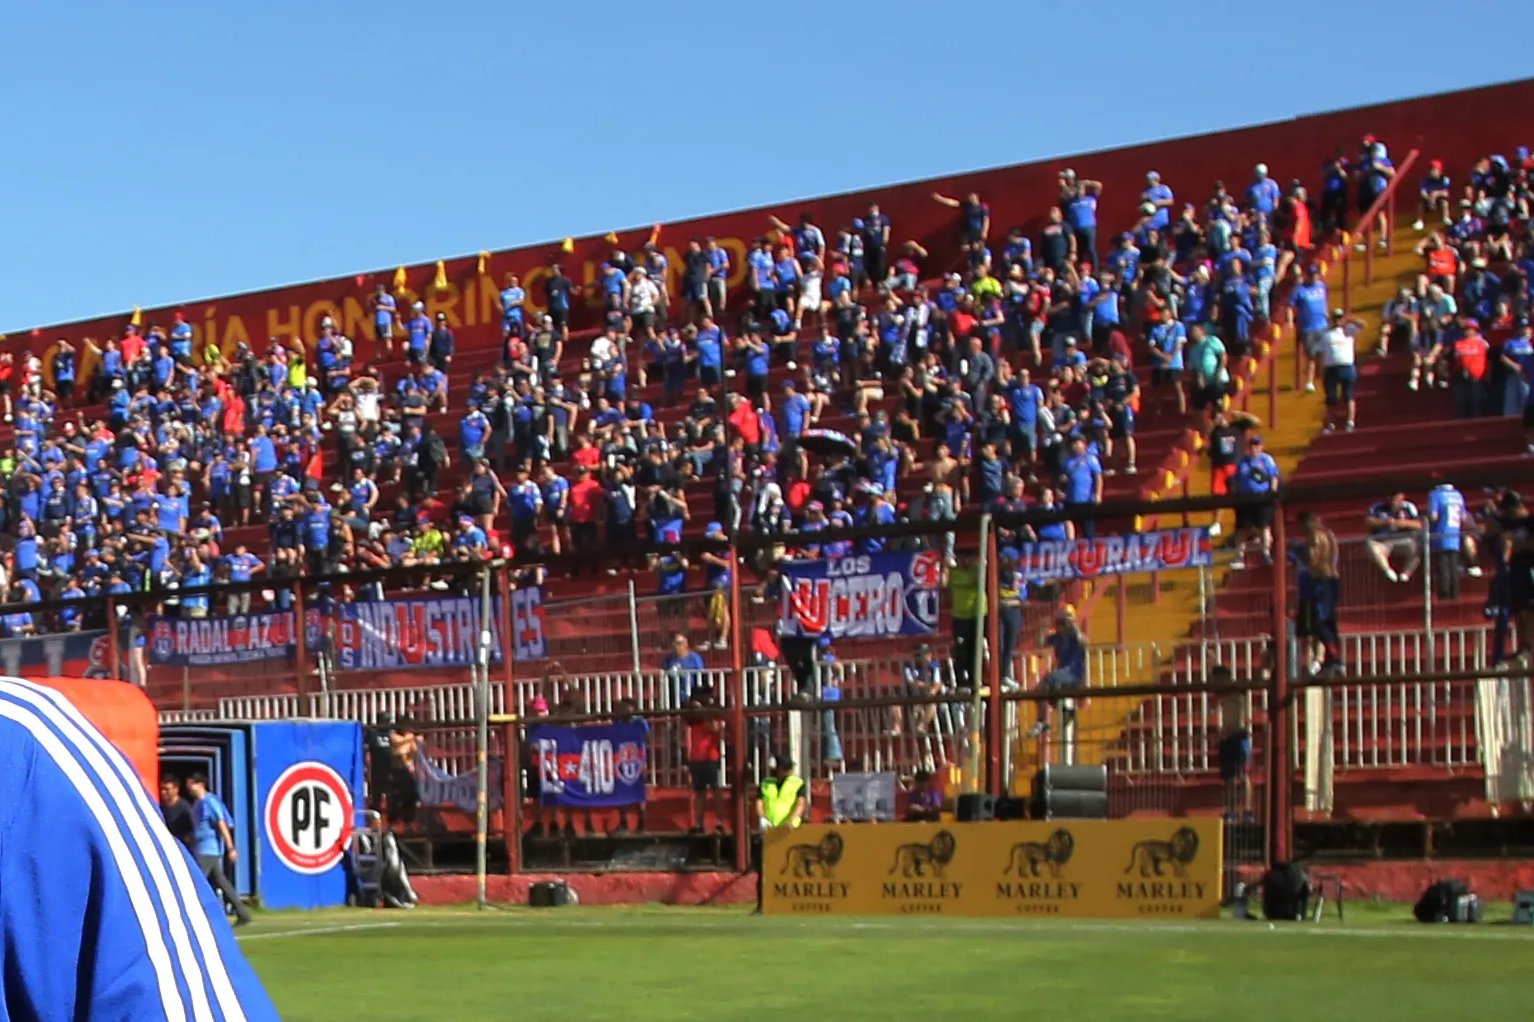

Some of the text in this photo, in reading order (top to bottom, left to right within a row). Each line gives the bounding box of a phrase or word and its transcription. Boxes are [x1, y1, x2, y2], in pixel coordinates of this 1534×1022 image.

[826, 556, 871, 576] LOS
[777, 571, 904, 638] LUCERO
[176, 611, 298, 655] RADAL AZUL
[357, 586, 544, 667] INDUSTRIAES
[539, 738, 616, 794] EL 410
[291, 785, 331, 850] PF
[774, 882, 851, 899] MARLEY
[882, 882, 964, 899] MARLEY
[996, 881, 1083, 899] MARLEY
[1117, 881, 1206, 900] MARLEY
